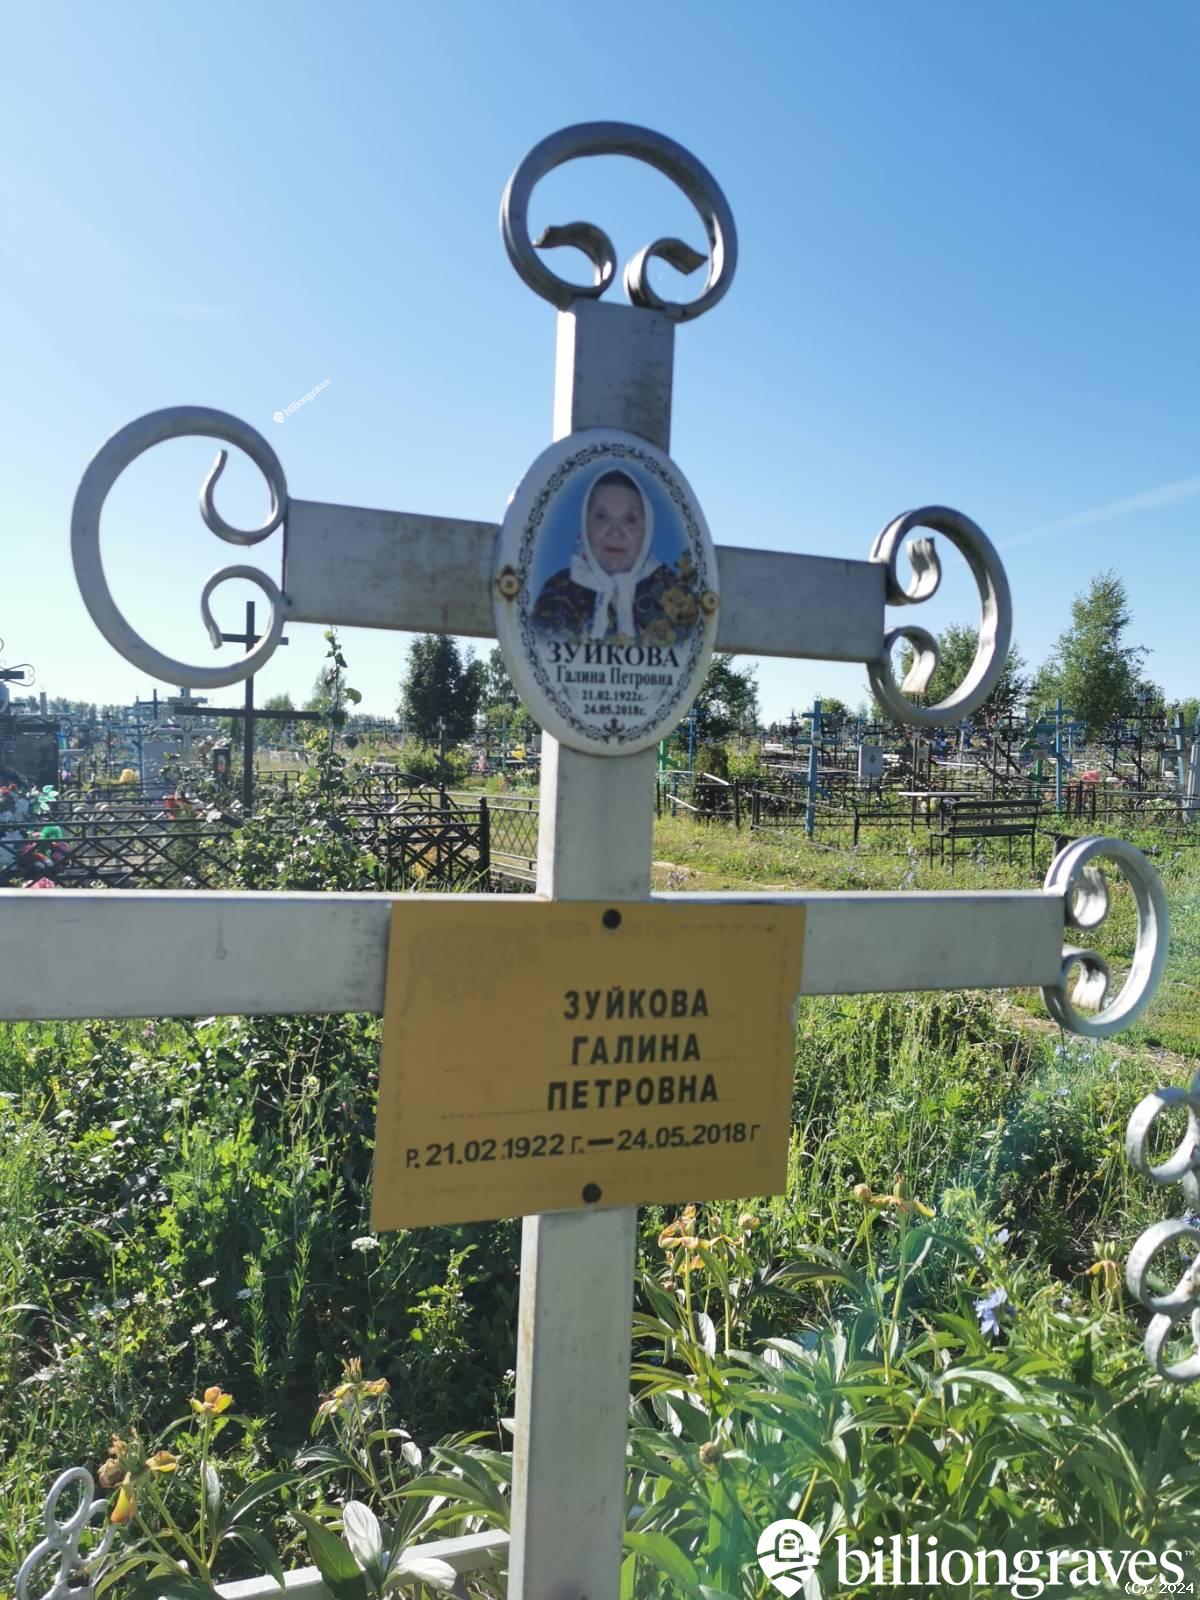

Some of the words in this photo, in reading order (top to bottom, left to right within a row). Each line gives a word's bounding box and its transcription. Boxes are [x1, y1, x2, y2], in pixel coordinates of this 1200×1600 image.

[547, 638, 680, 668] ЗУЙКОВА
[556, 665, 606, 684] Галина
[610, 667, 673, 689] Петровна
[563, 984, 709, 1020] ЗУЙКОВА
[571, 1032, 701, 1065] ГАЛИНА
[547, 1073, 719, 1111] ПЕТРОВНА
